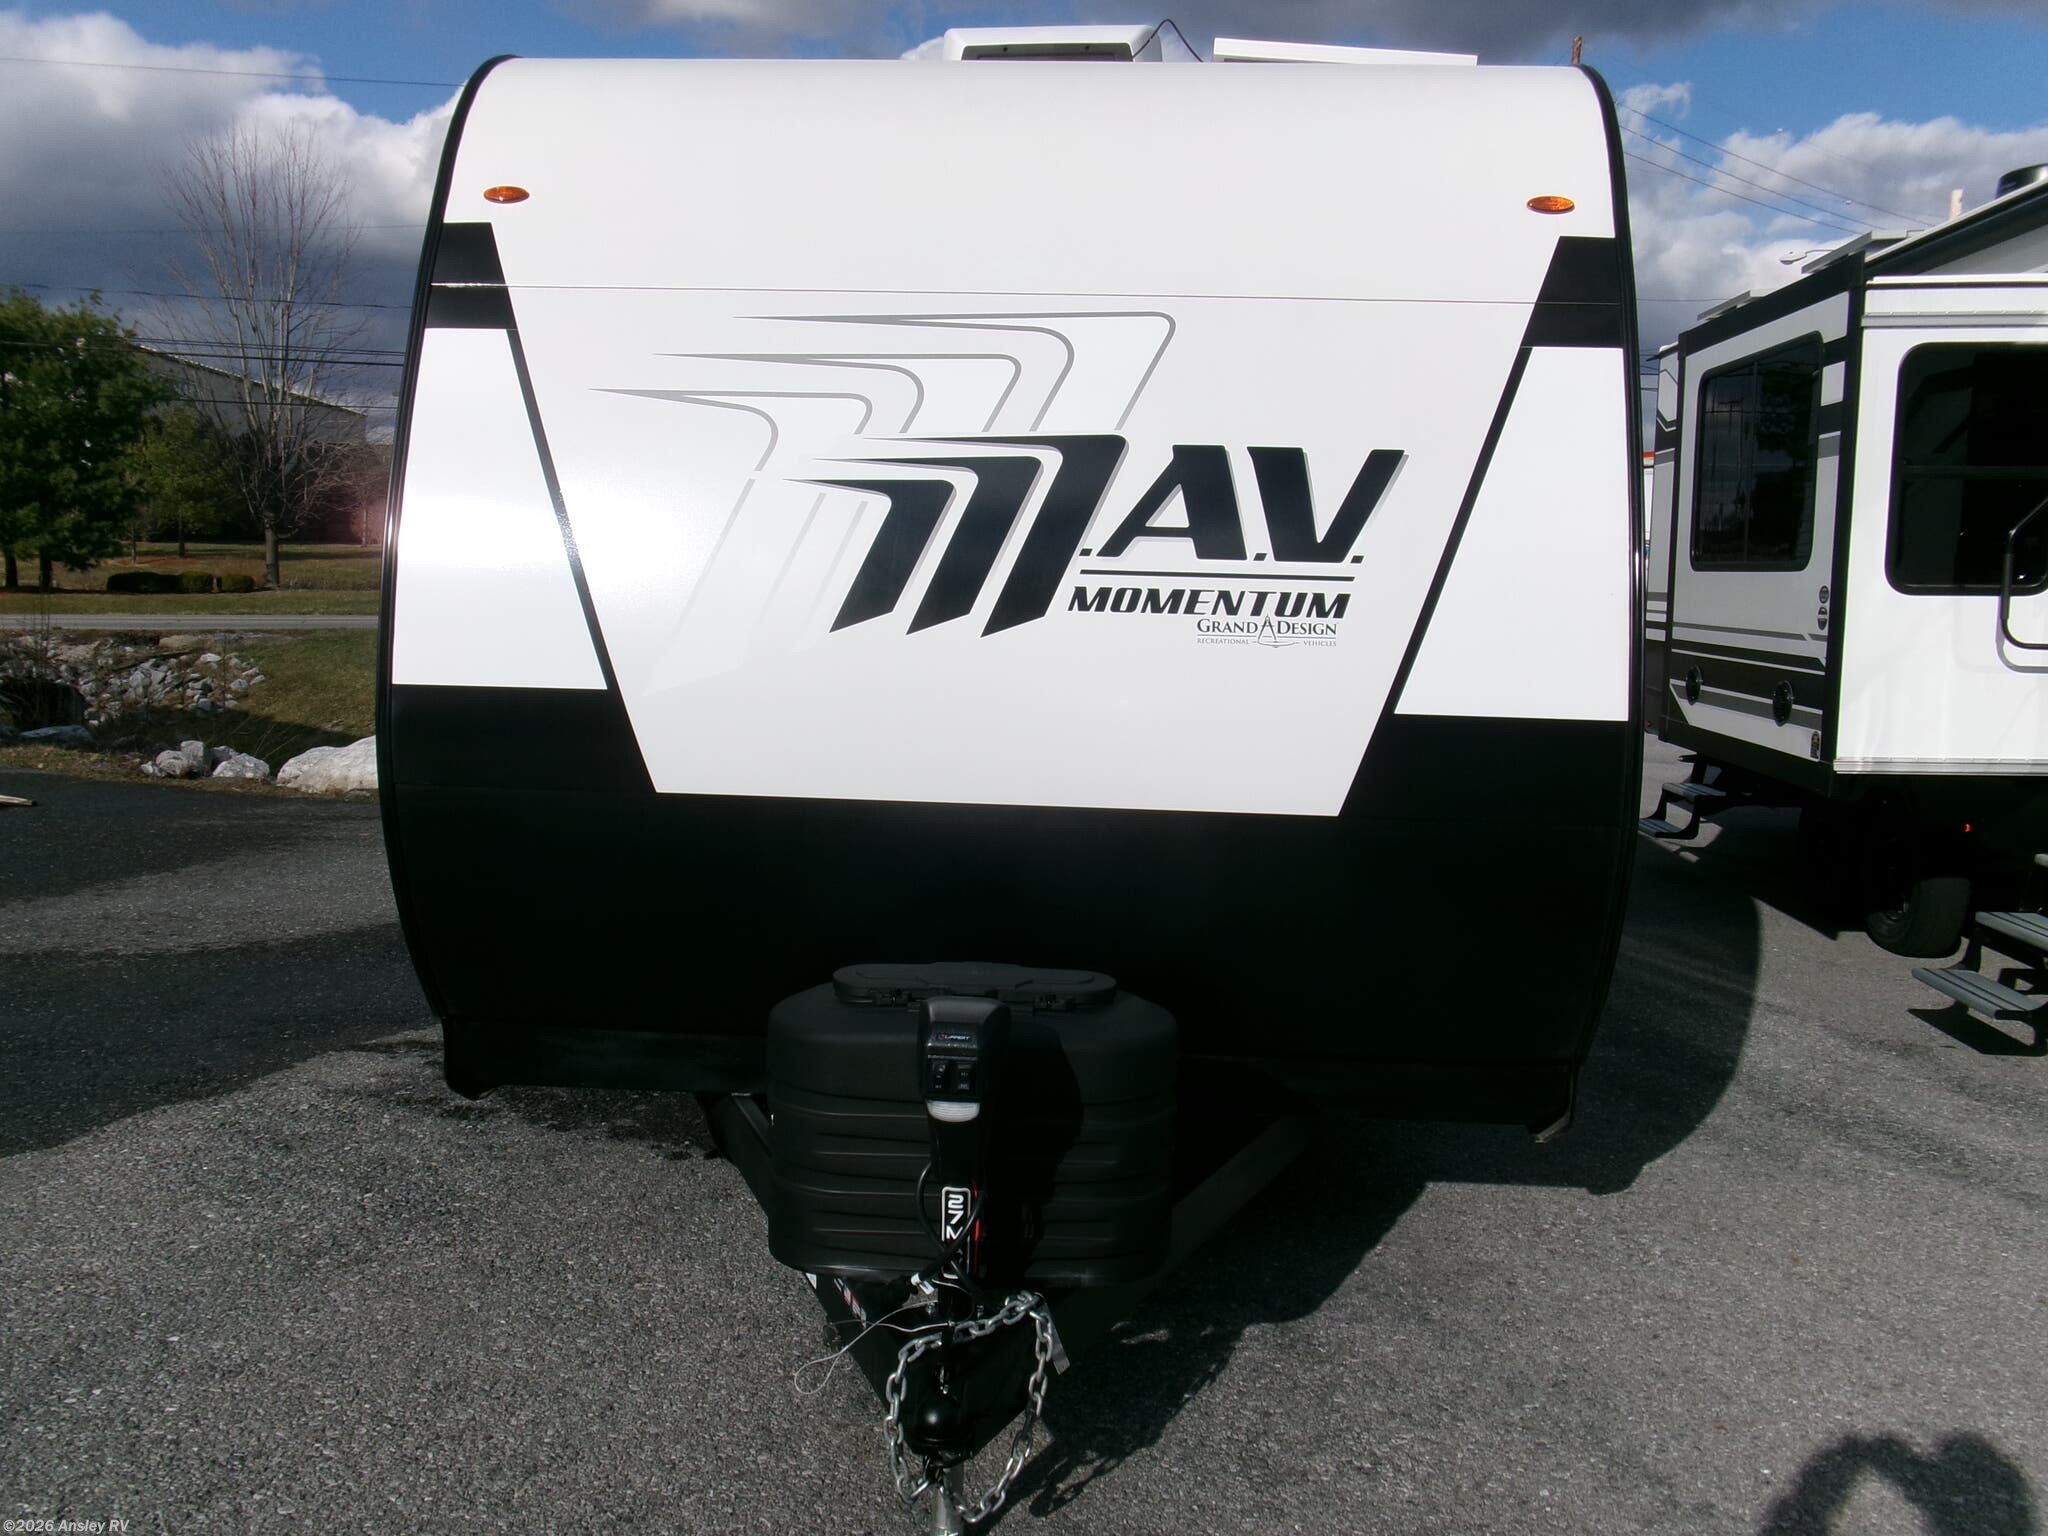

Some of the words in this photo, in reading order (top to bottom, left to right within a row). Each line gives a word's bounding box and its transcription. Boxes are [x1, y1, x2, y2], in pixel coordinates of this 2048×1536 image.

[1067, 586, 1350, 619] MOMENTUM
[1197, 618, 1259, 634] GRAND
[1277, 620, 1337, 636] DESIGN
